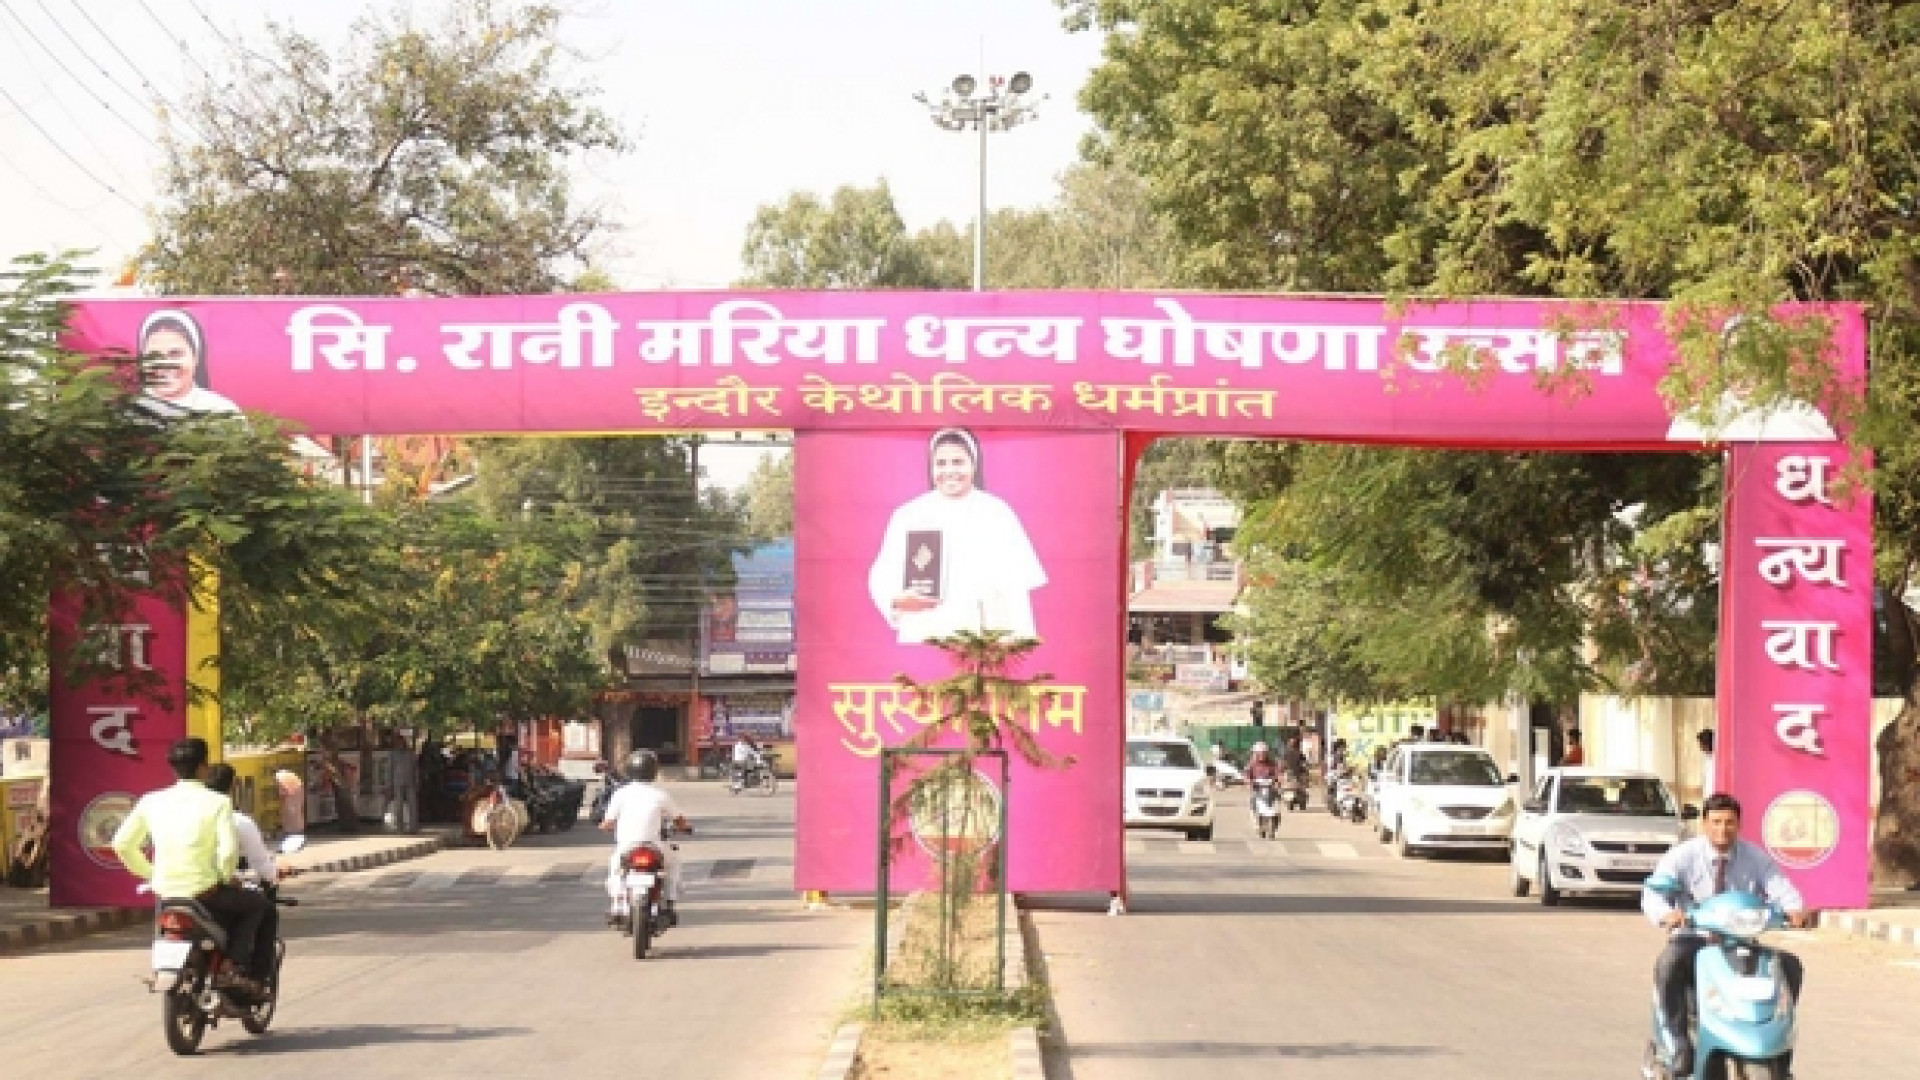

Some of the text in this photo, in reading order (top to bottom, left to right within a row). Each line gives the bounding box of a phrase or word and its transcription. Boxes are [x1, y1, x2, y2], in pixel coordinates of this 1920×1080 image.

[286, 306, 417, 374] सि.
[441, 302, 617, 370] रानी
[637, 300, 886, 366] मरिया
[904, 314, 1083, 365] धन्य
[1102, 297, 1387, 372] घोषणा
[633, 372, 1278, 421] इन्दौर केथोलिक धर्मप्रांत
